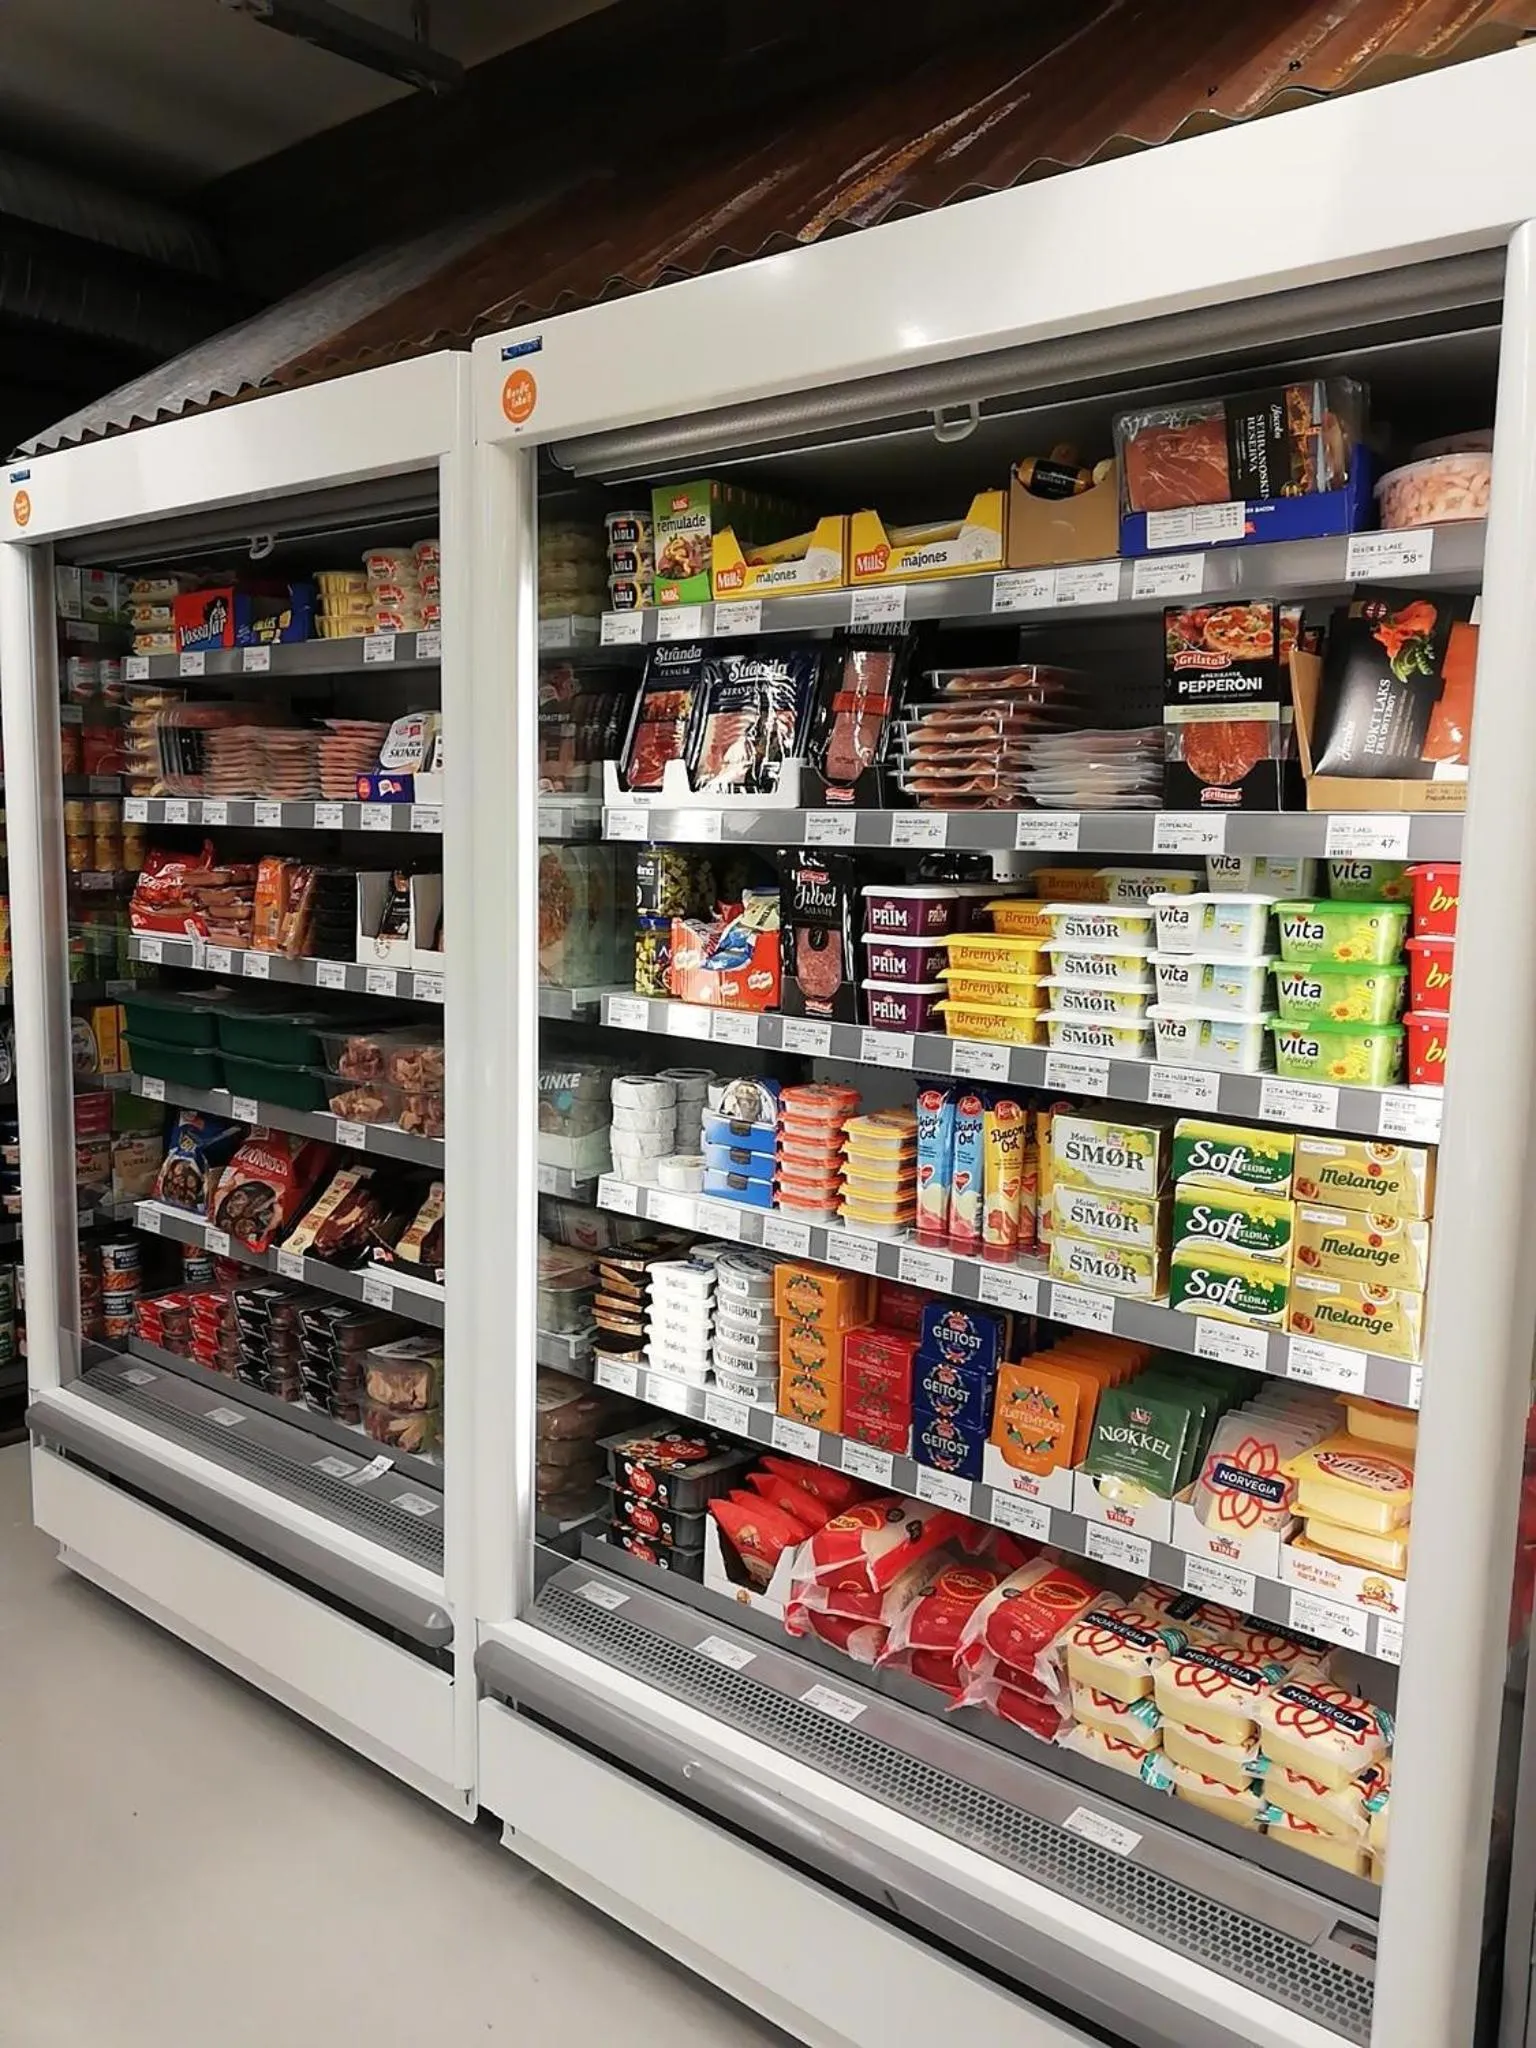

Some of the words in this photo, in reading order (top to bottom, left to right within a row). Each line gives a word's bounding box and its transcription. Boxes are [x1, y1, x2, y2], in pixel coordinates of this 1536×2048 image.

[657, 514, 706, 532] remulade
[901, 550, 947, 569] majones
[756, 568, 797, 584] majones
[1211, 856, 1241, 870] vita
[1332, 862, 1372, 880] vita
[1429, 886, 1459, 912] br
[872, 909, 907, 926] PRIM
[1004, 911, 1049, 926] Bremyk
[1160, 909, 1189, 924] vita
[1065, 923, 1119, 938] SMØR
[1283, 921, 1324, 940] vita
[872, 956, 907, 974] PRIM
[960, 948, 1010, 963] Bremykt
[1065, 960, 1119, 976] SMØR
[1160, 967, 1188, 982] vita
[1426, 963, 1452, 989] br
[959, 980, 1009, 996] Bremykt
[1281, 980, 1322, 999] vita
[872, 1001, 907, 1020] PRIM
[1063, 995, 1117, 1012] SMØR
[956, 1013, 1007, 1029] Bremykt
[1157, 1022, 1186, 1037] vita
[1062, 1030, 1115, 1047] SMØR
[1279, 1038, 1319, 1057] vita
[1066, 1141, 1145, 1171] SMØR
[1188, 1141, 1250, 1176] Soft
[1319, 1167, 1399, 1196] Melange
[1070, 1205, 1139, 1233] SMØR
[1186, 1206, 1249, 1242] Soft
[1320, 1237, 1400, 1267] Melange
[1069, 1254, 1137, 1284] SMØR
[1184, 1269, 1247, 1306] Soft
[1315, 1304, 1394, 1335] Melange
[932, 1325, 983, 1349] GEITOST
[922, 1377, 970, 1404] GEITOST
[921, 1432, 970, 1458] GEITOST
[1099, 1425, 1172, 1461] NØKKEL
[1219, 1469, 1277, 1496] NORVEGIA
[1088, 1613, 1148, 1644] NORVEGIA
[1184, 1650, 1251, 1681] NORVEGIA
[1287, 1689, 1358, 1726] NORVEGIA
